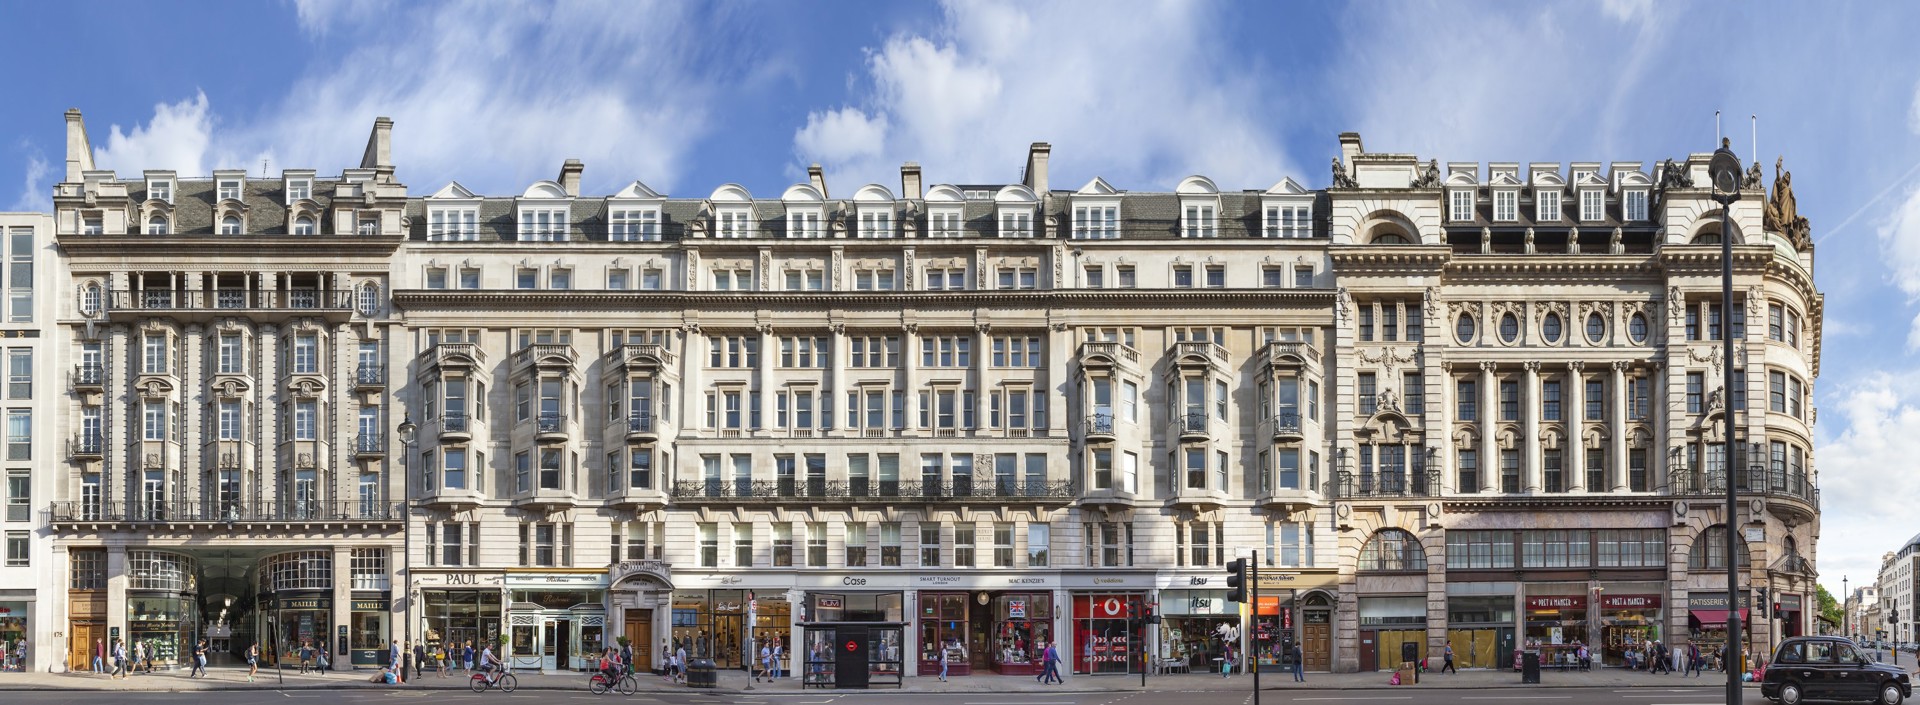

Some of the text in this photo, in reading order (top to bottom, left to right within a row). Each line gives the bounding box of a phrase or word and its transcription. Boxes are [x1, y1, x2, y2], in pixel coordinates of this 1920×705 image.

[446, 574, 480, 585] PAUL
[843, 576, 867, 586] Case
[1190, 576, 1207, 586] itsu
[291, 600, 319, 608] MAILLE
[1191, 596, 1211, 608] itsu
[1554, 599, 1572, 607] MANGER
[1690, 598, 1724, 606] PATISSERIE
